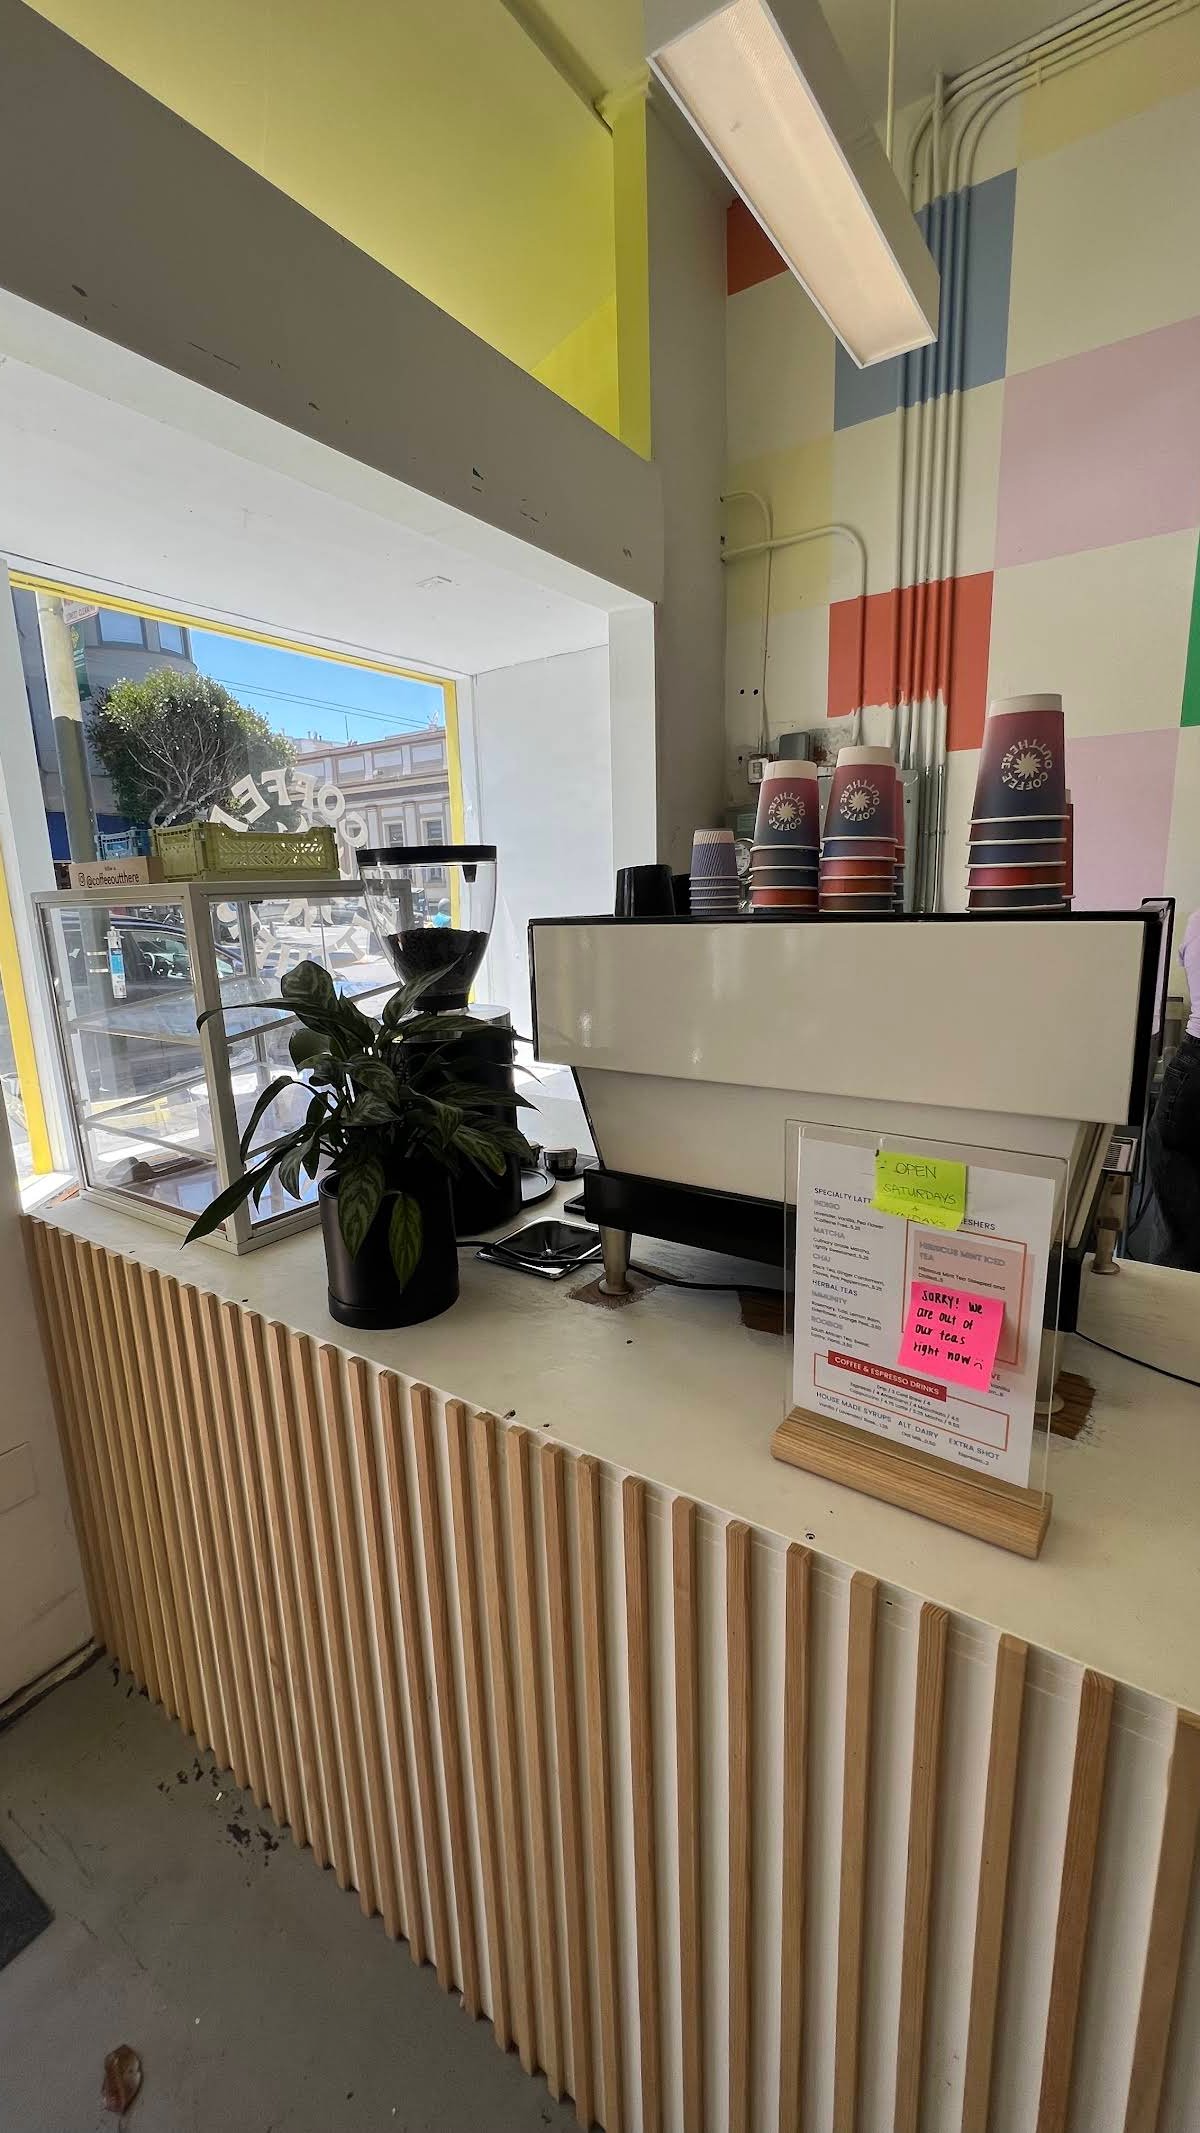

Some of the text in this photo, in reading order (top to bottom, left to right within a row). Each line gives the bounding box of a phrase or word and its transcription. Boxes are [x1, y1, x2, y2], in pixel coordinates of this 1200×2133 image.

[1002, 772, 1048, 790] COFFEE
[895, 1162, 937, 1179] OPEN
[814, 1187, 873, 1204] SPECIALTY LATT
[883, 1183, 957, 1204] SATURDAYS
[813, 1226, 846, 1239] MATCHA
[961, 1218, 996, 1231] ESHERS
[919, 1252, 935, 1262] TEA
[812, 1279, 858, 1297] HERBAL TEAS
[921, 1289, 960, 1310] SORRY!
[916, 1306, 974, 1331] are out of
[915, 1323, 966, 1345] our teas
[913, 1341, 972, 1365] right now
[834, 1356, 940, 1396] COFFEE & ESPRESSO DRINKS
[816, 1391, 892, 1423] HOUSE MADE SYRUPS
[915, 1426, 939, 1440] DAIRY
[948, 1437, 1000, 1461] EXTRA SHOT
